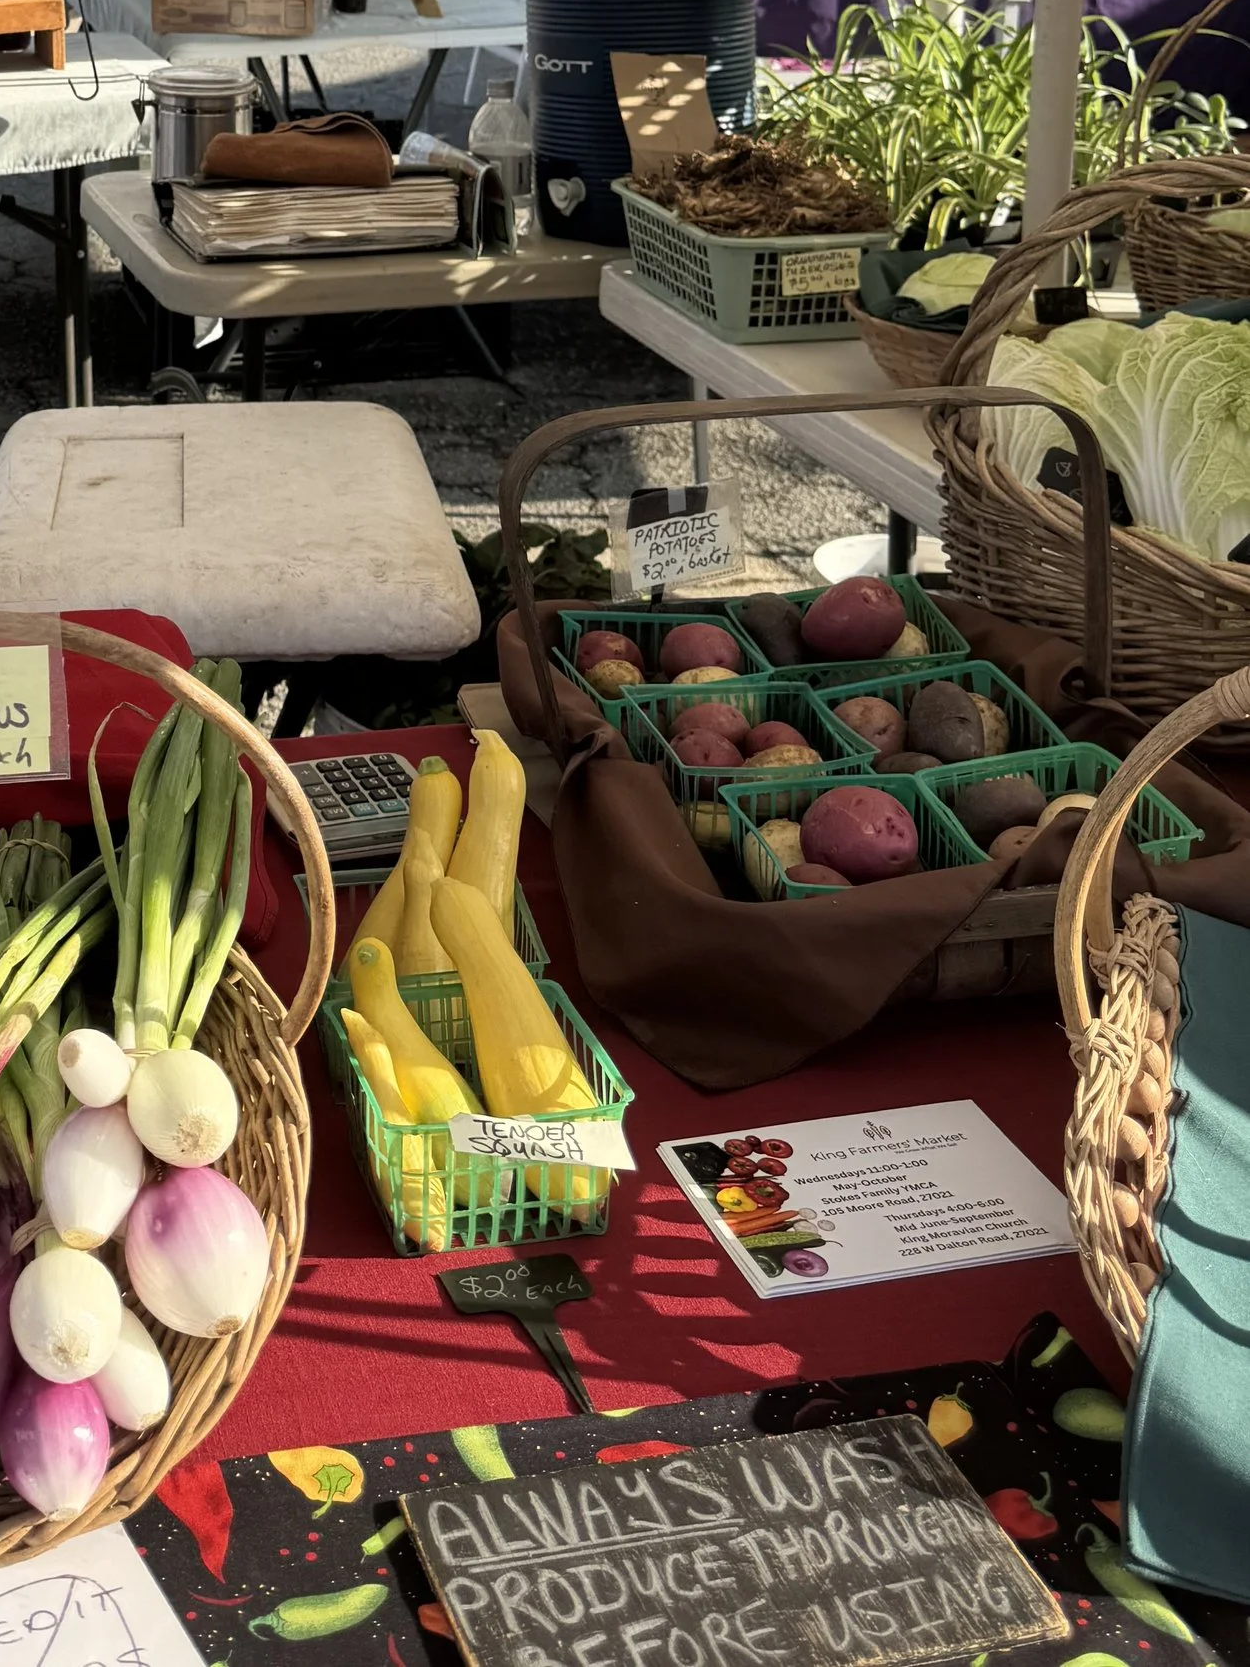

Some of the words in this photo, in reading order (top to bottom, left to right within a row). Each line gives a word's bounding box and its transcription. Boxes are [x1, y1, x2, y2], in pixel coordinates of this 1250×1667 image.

[534, 53, 593, 74] GOTT
[634, 512, 720, 547] PATRIOTIC
[649, 530, 717, 559] POTATOES
[472, 1118, 576, 1142] TENDER
[468, 1136, 584, 1161] SQUASH
[810, 1148, 847, 1162] King
[848, 1139, 911, 1156] Farmers'
[913, 1132, 968, 1147] Market
[794, 1168, 867, 1186] Wednesdays
[866, 1159, 928, 1175] 11:00-1:00
[832, 1174, 908, 1192] May-October
[820, 1191, 861, 1206] Stokes
[861, 1185, 900, 1201] Family
[900, 1181, 938, 1193] YMCA
[821, 1207, 845, 1217] 105
[845, 1202, 884, 1215] Moore
[885, 1195, 920, 1208] Road,
[919, 1190, 954, 1202] 27021
[883, 1207, 946, 1224] Thursdays
[946, 1197, 1005, 1213] 4:00-6:00
[893, 1223, 918, 1234] Mid
[918, 1208, 1015, 1230] June-September
[898, 1247, 922, 1257] 228
[921, 1245, 935, 1253] W
[936, 1238, 978, 1252] Dalton
[978, 1232, 1013, 1245] Road,
[1012, 1227, 1049, 1239] 27021
[899, 1234, 929, 1246] King
[929, 1226, 984, 1241] Moravian
[984, 1218, 1029, 1231] Church
[426, 1458, 736, 1566] ALWAYS
[738, 1426, 937, 1515] WASH
[445, 1543, 739, 1645] PRODUCE
[515, 1598, 799, 1667] BEFORE
[811, 1562, 1012, 1653] USING
